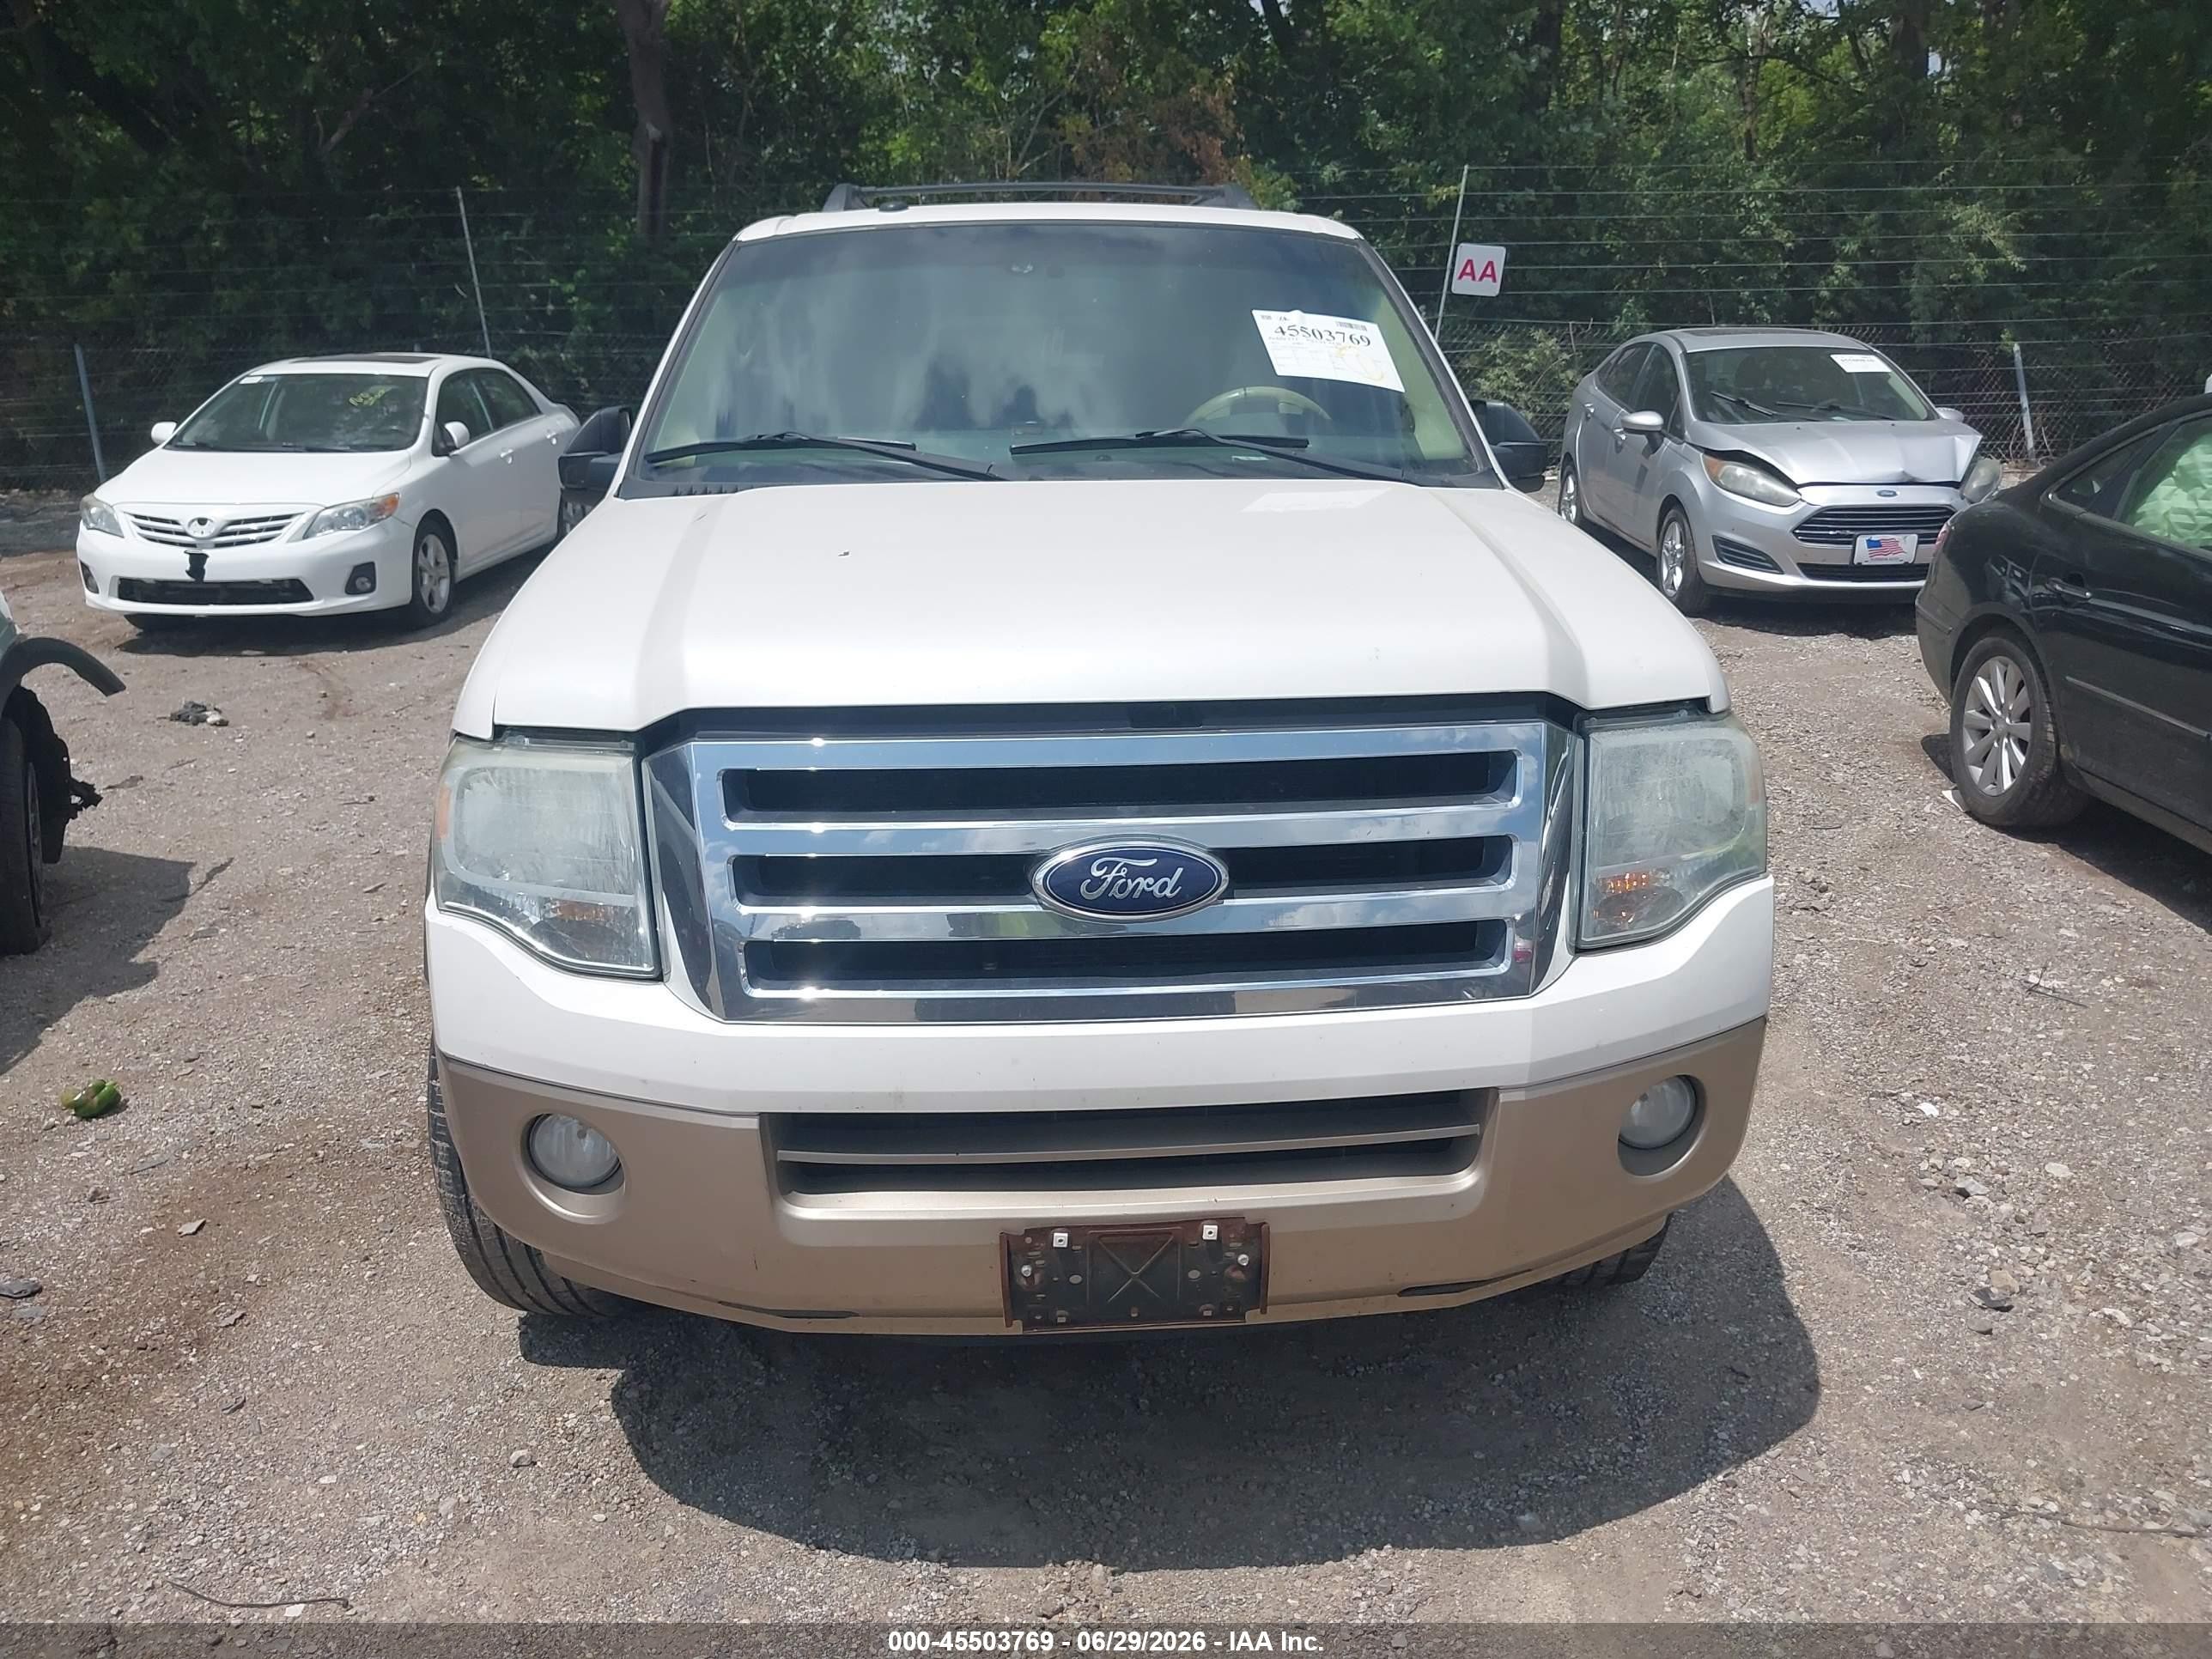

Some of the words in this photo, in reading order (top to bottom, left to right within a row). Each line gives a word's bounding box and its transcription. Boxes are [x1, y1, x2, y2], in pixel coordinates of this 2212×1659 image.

[1457, 258, 1498, 283] AA
[1274, 325, 1371, 347] 45503769
[1080, 857, 1183, 900] Ford
